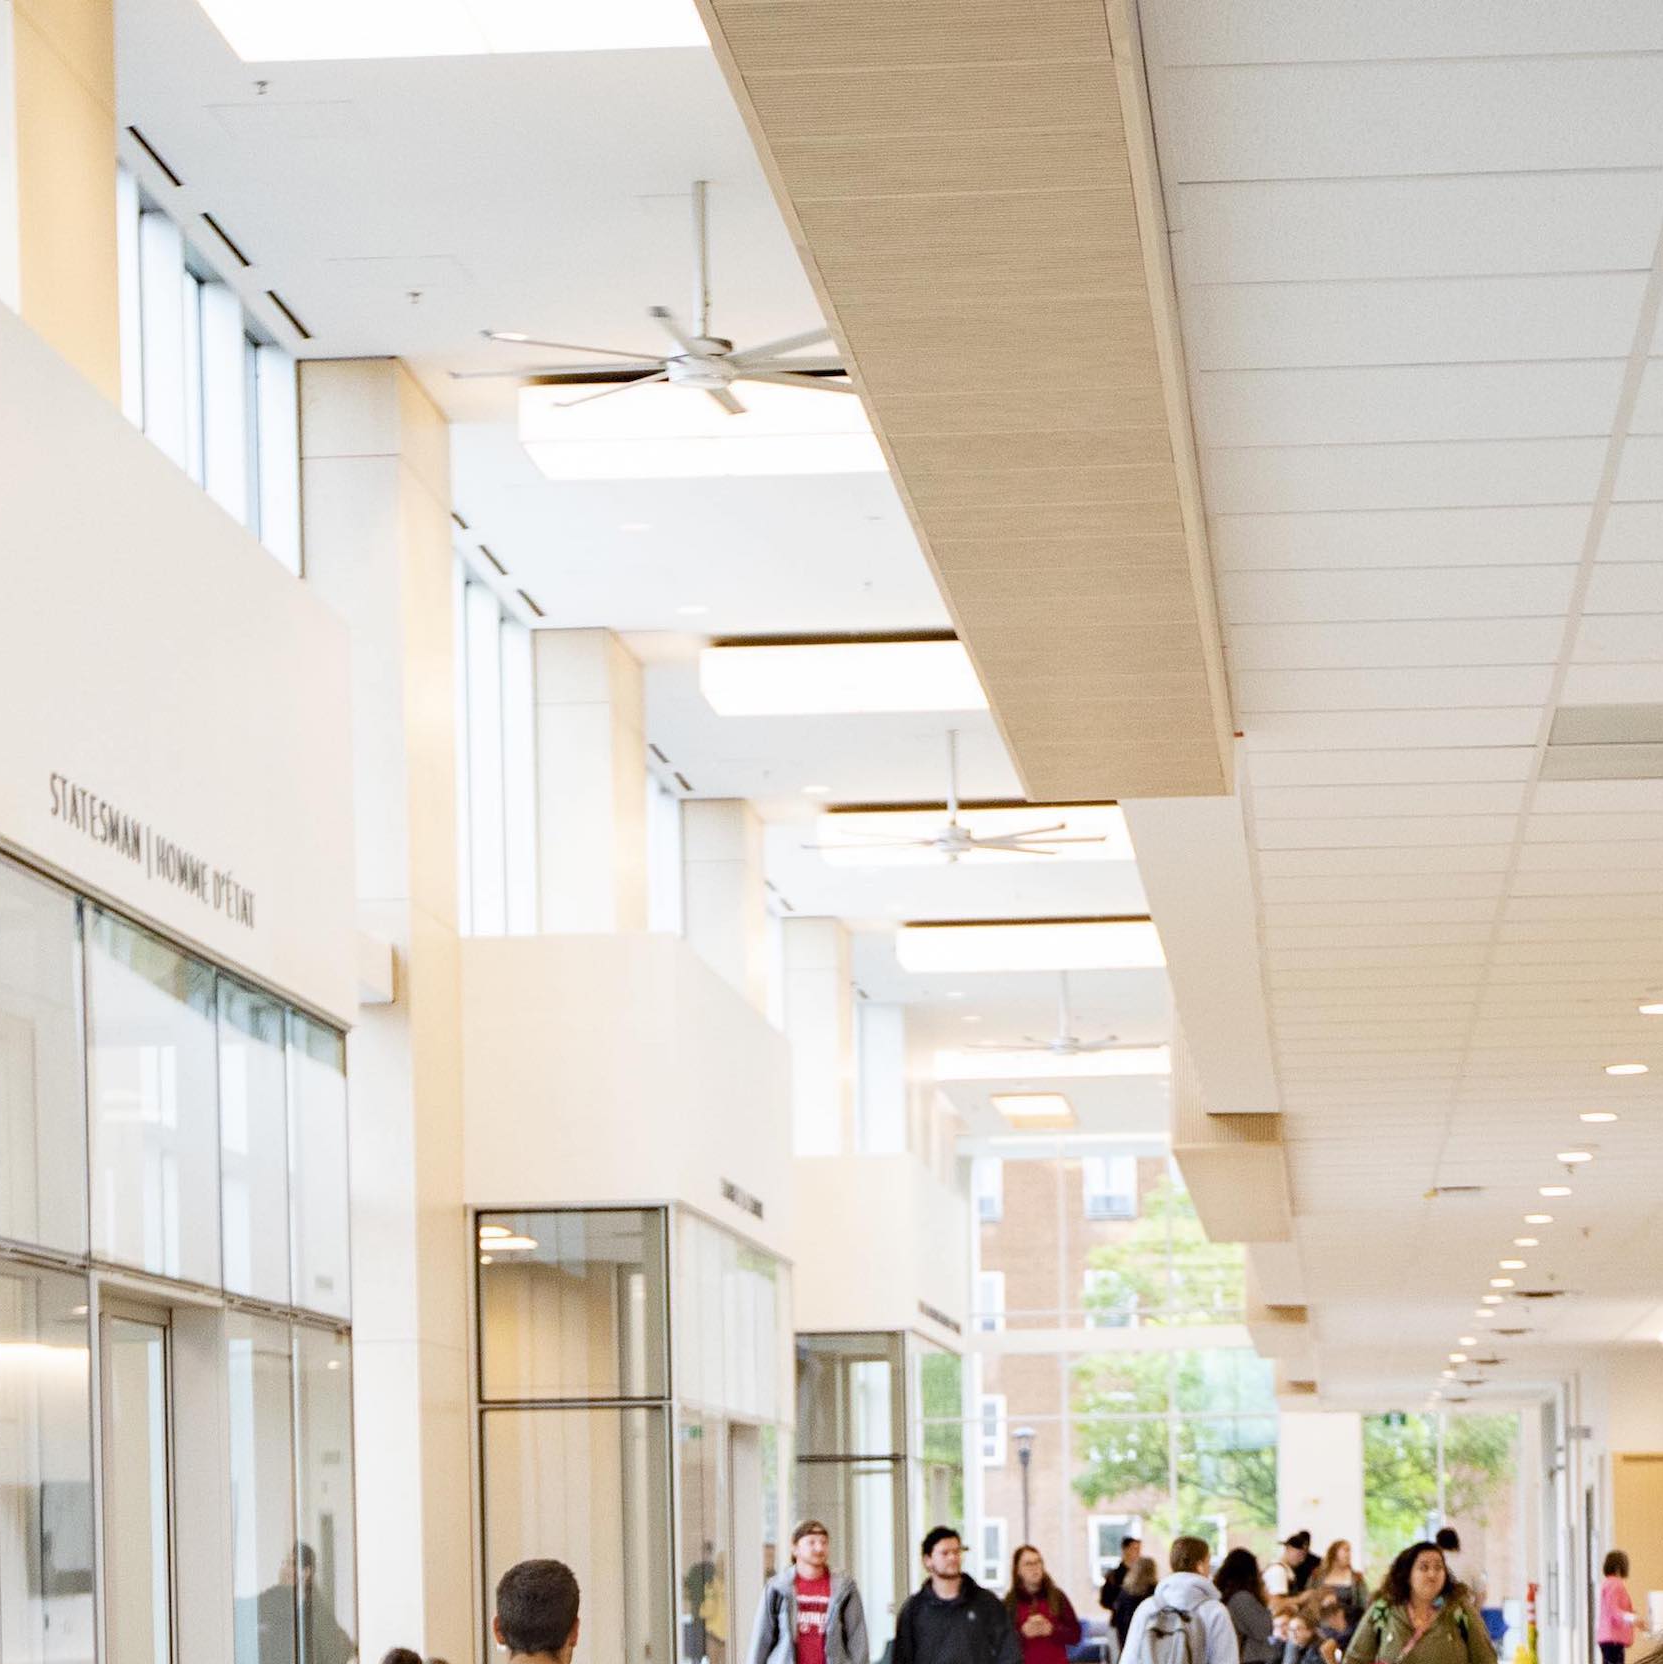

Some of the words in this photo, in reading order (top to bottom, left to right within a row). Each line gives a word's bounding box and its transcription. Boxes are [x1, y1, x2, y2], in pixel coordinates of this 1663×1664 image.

[49, 772, 141, 863] STATESMAN
[155, 834, 209, 904] HOMME
[212, 869, 255, 930] D'ÉTAT
